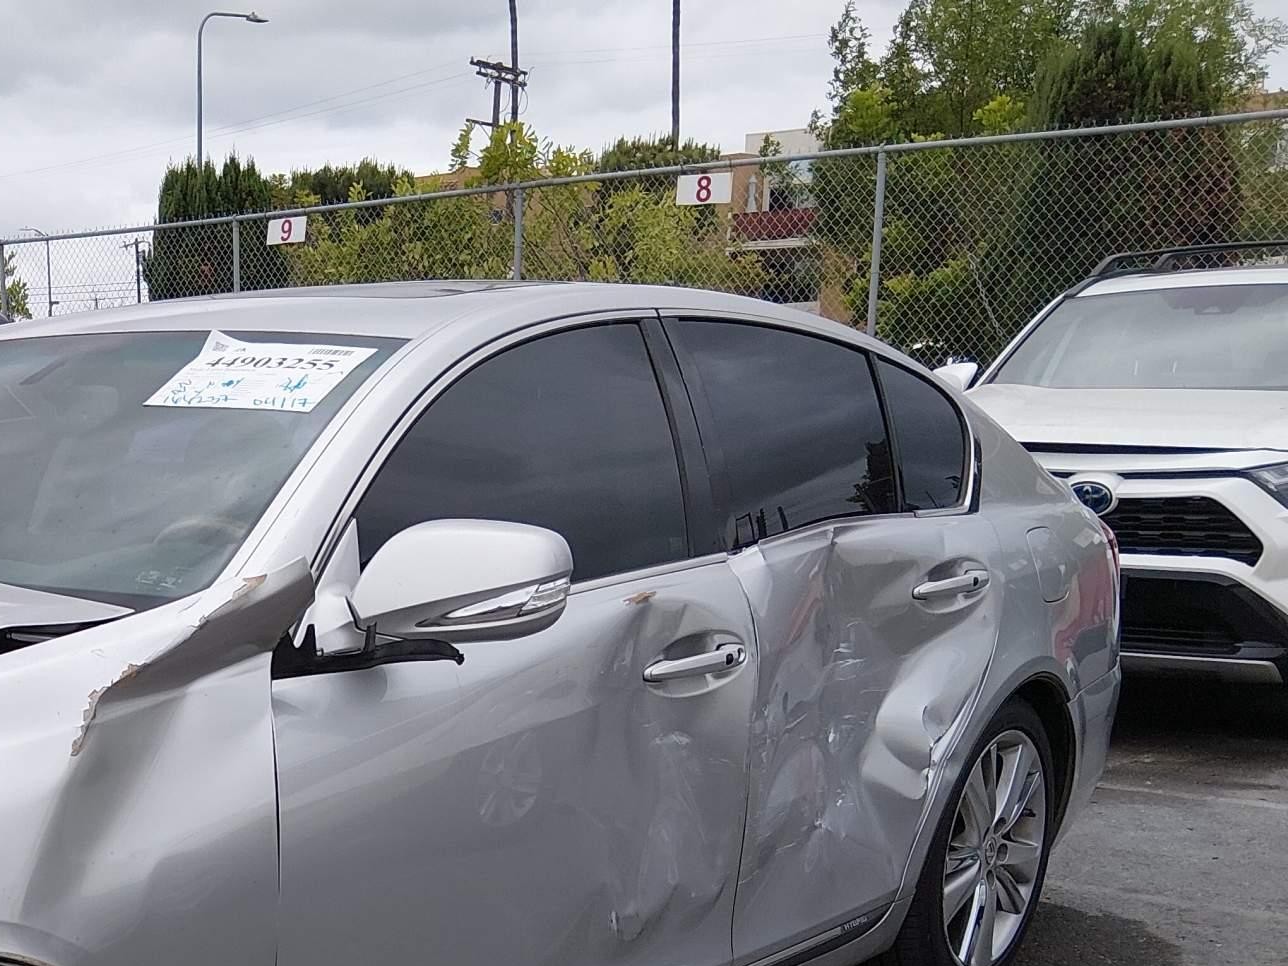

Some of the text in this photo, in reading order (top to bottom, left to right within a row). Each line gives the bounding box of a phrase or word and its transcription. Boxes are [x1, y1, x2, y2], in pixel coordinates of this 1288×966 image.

[695, 175, 712, 203] 8
[280, 219, 293, 242] 9
[205, 355, 339, 370] 44903255
